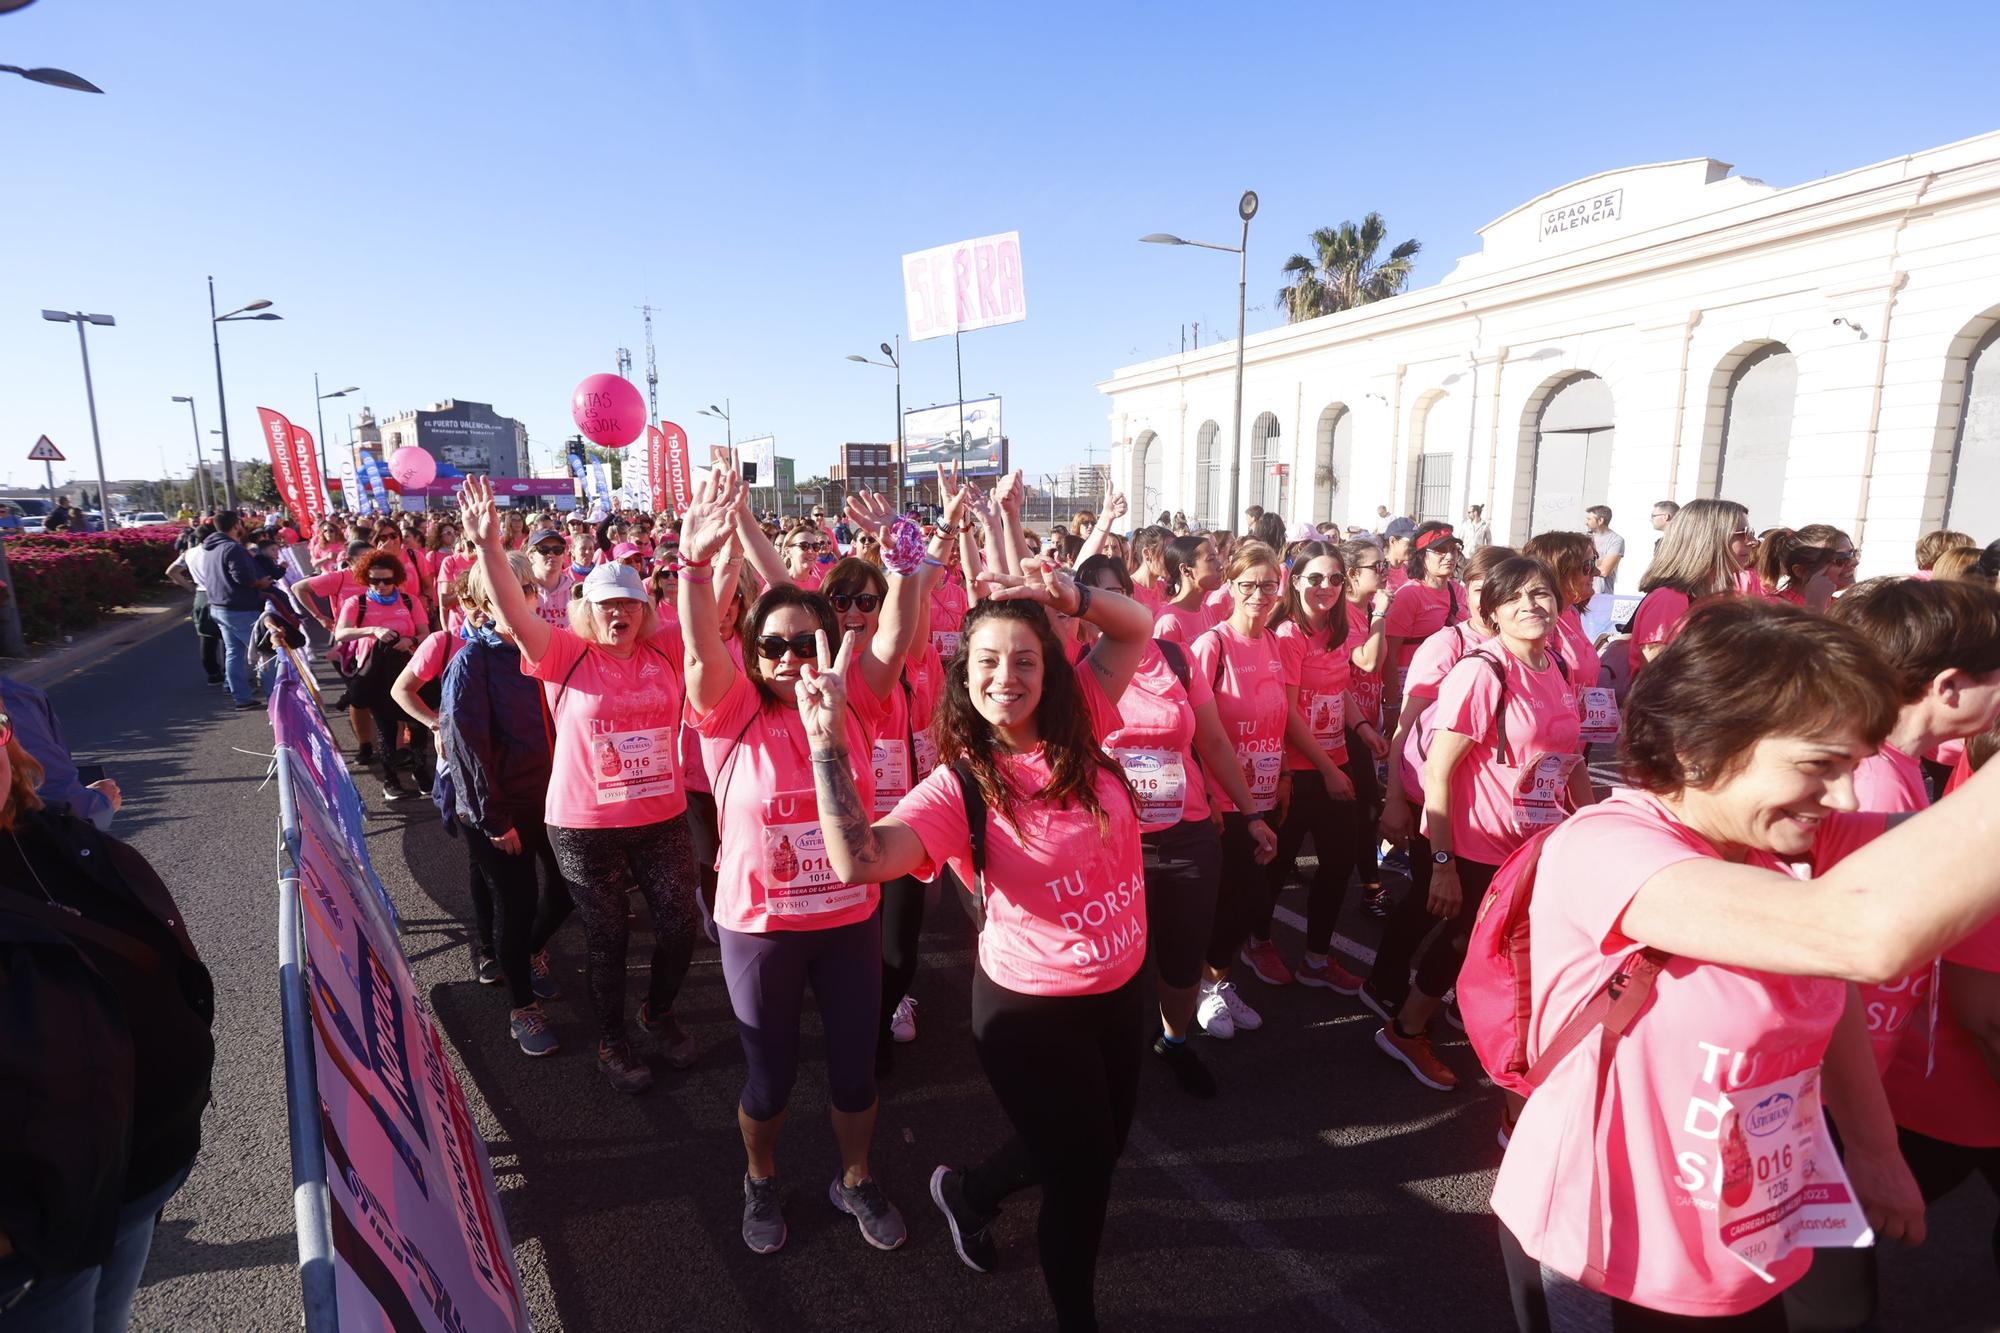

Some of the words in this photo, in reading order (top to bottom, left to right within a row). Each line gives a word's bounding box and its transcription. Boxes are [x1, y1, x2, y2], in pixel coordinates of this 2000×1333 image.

[1548, 205, 1585, 224] GRAO
[1593, 195, 1614, 210] DE
[1544, 208, 1615, 236] VALENCIA
[433, 420, 459, 428] PUERTO
[1588, 710, 1606, 719] 016
[590, 718, 614, 734] TU
[1238, 721, 1257, 736] TU
[624, 756, 650, 769] 016
[1130, 778, 1158, 790] 016
[1257, 775, 1277, 785] 016
[1139, 791, 1153, 799] 238
[762, 798, 796, 819] TU
[800, 838, 825, 847] ASTURI
[809, 872, 831, 882] 1014
[779, 887, 808, 896] CARRERA
[1045, 870, 1085, 903] TU
[776, 900, 809, 910] OYSHO
[1071, 915, 1142, 967] SUMA
[1867, 1002, 1910, 1033] SU
[1698, 1041, 1759, 1088] TU
[436, 1100, 451, 1122] a
[1757, 1144, 1794, 1181] 016
[1766, 1179, 1789, 1200] 1236
[442, 1122, 500, 1295] Kilómetro
[1730, 1215, 1766, 1236] CARRERA
[1766, 1212, 1777, 1225] DE
